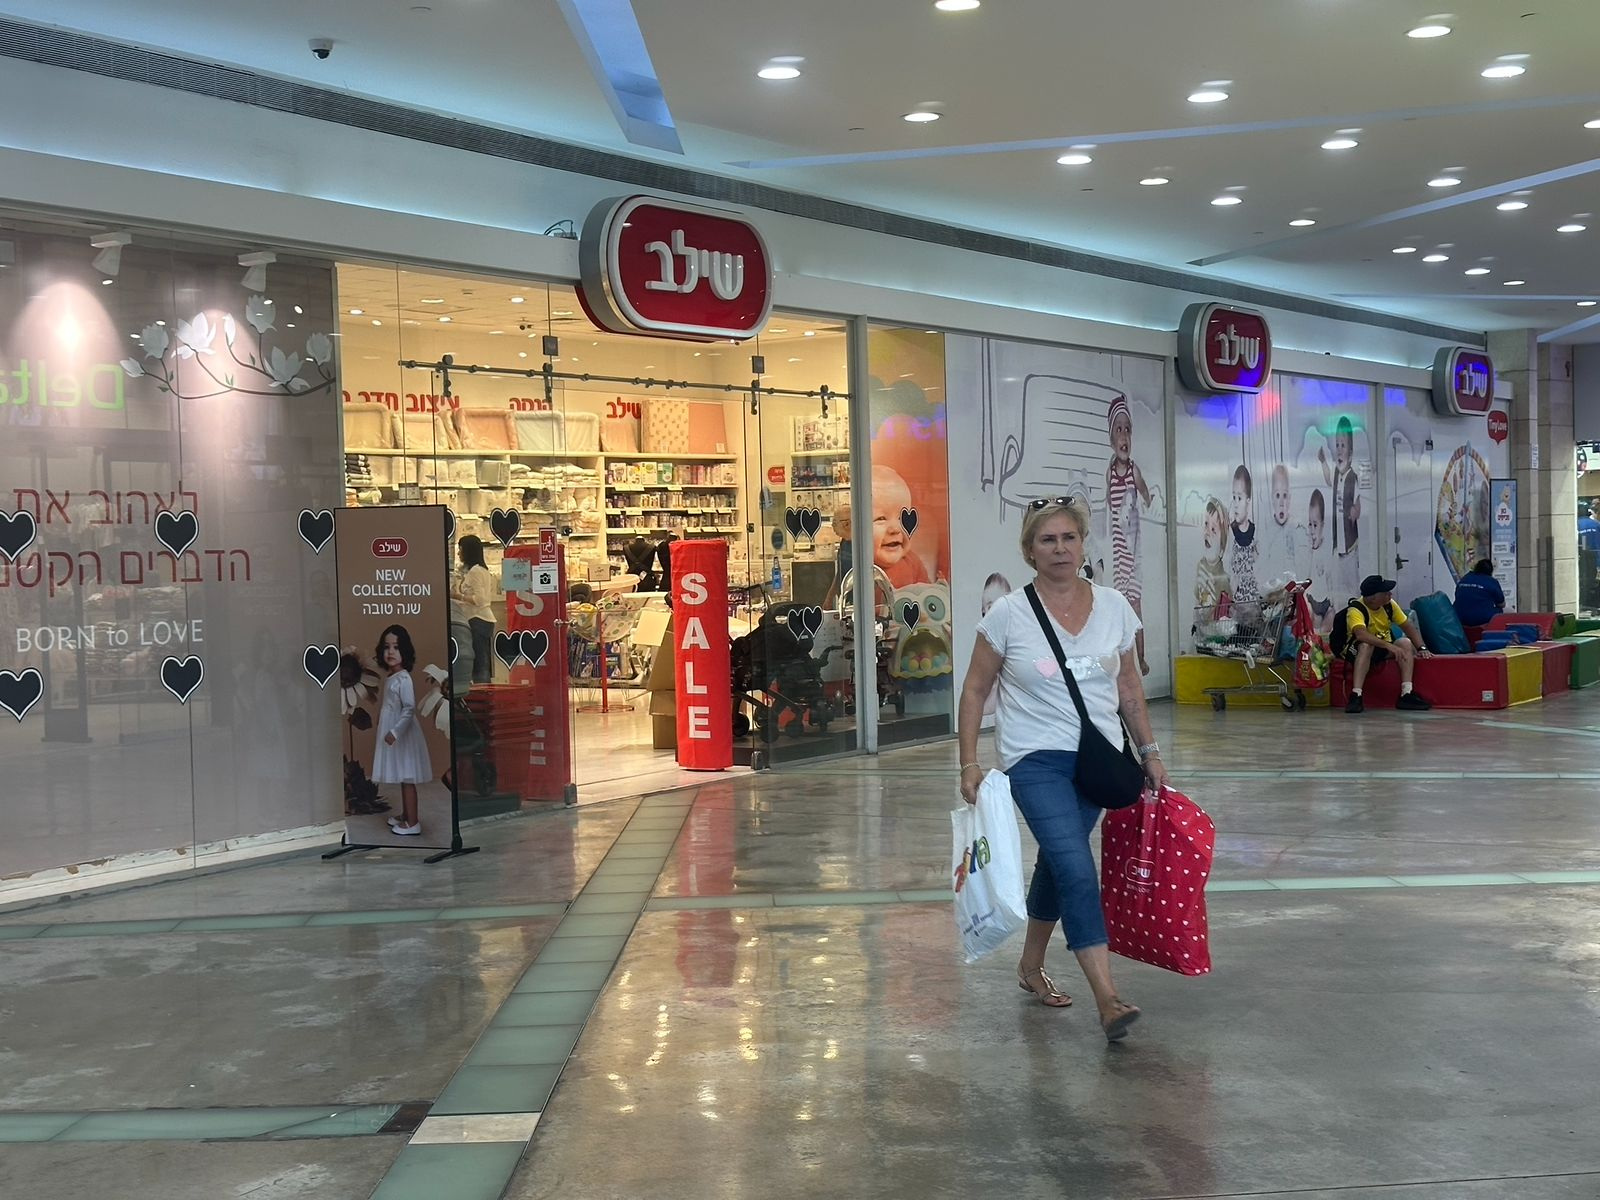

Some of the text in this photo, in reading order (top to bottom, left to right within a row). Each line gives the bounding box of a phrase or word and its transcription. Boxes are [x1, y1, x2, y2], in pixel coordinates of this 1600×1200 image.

[644, 229, 745, 301] שילב
[1214, 323, 1261, 370] שילב
[1459, 363, 1488, 398] שילב
[607, 397, 641, 419] שילב
[13, 480, 199, 525] לאהוב את
[379, 541, 401, 553] שילב
[119, 549, 251, 585] הדברים
[376, 569, 406, 581] NEW
[352, 584, 431, 596] COLLECTION
[363, 603, 421, 615] שנה טובה
[16, 619, 204, 652] BORN to LOVE
[680, 572, 712, 739] SALE
